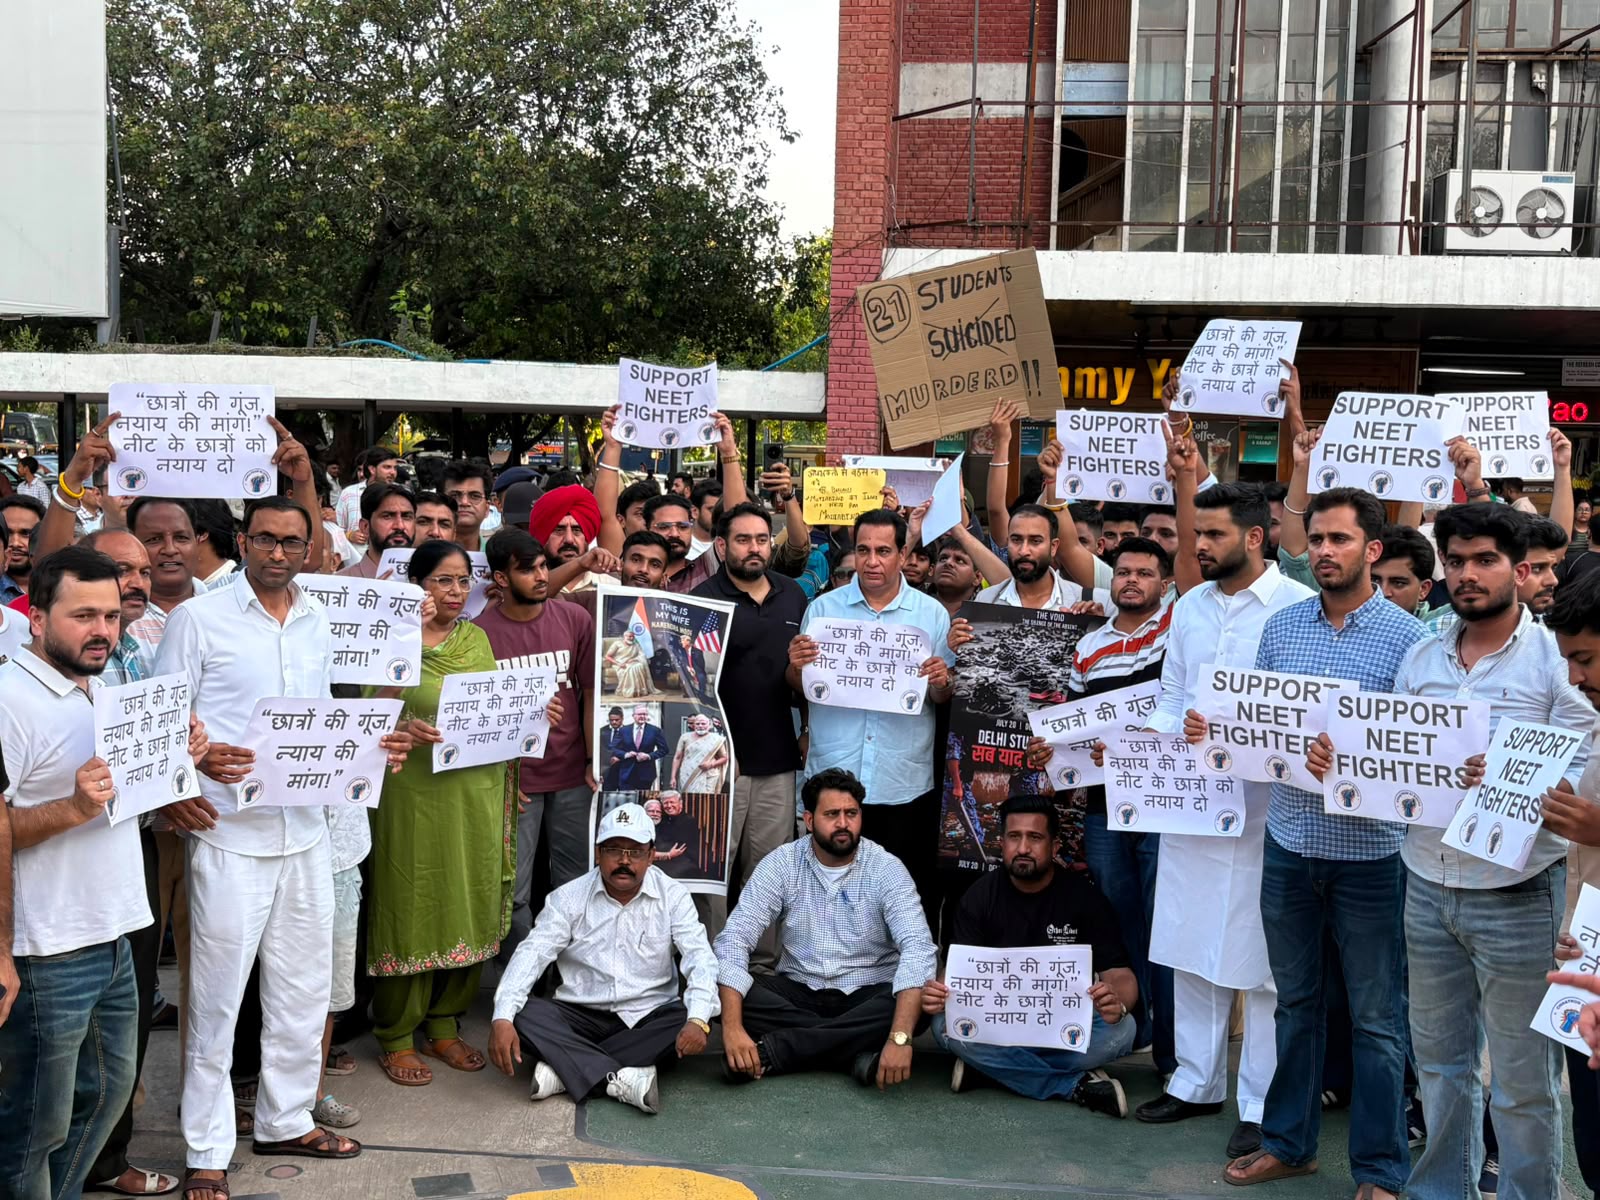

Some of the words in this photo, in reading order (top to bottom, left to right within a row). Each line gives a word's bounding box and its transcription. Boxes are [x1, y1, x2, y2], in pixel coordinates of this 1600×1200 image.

[867, 290, 907, 333] 21
[917, 266, 1013, 311] STUDENTS
[1240, 326, 1256, 342] की
[1193, 345, 1216, 357] याय
[1222, 342, 1240, 359] की
[630, 364, 711, 387] SUPPORT
[1184, 358, 1206, 374] नीट
[1211, 359, 1225, 375] के
[1231, 360, 1259, 376] छात्रों
[1265, 361, 1282, 377] को
[645, 387, 694, 405] NEET
[1242, 377, 1256, 395] दो
[137, 390, 187, 411] “छात्रों
[197, 391, 219, 411] की
[1334, 396, 1450, 420] SUPPORT
[1449, 395, 1535, 412] UPPORT
[1548, 398, 1589, 422] ao
[178, 412, 200, 432] की
[625, 402, 708, 424] FIGHTERS
[1069, 414, 1160, 434] SUPPORT
[1193, 421, 1208, 430] old
[1353, 421, 1417, 442] NEET
[1468, 415, 1517, 432] NEET
[123, 433, 157, 453] नीट
[168, 433, 185, 453] के
[195, 433, 236, 453] छात्रों
[245, 434, 267, 453] को
[1088, 436, 1138, 455] NEET
[1466, 435, 1541, 451] GHTERS
[217, 455, 235, 474] दो
[1067, 455, 1160, 477] FIGHTERS
[1322, 443, 1441, 469] FIGHTERS
[357, 588, 381, 610] की
[660, 602, 678, 613] THIS
[680, 607, 688, 615] IS
[655, 611, 670, 619] MY
[671, 614, 691, 626] WIFE
[1036, 611, 1048, 620] THE
[1050, 612, 1064, 622] VOID
[369, 620, 391, 640] की
[825, 624, 863, 640] “छात्रों
[870, 627, 888, 643] की
[854, 641, 872, 658] की
[812, 654, 839, 670] नीट
[845, 656, 859, 672] के
[866, 660, 897, 676] छात्रों
[461, 677, 495, 695] “छात्रों
[501, 675, 518, 692] की
[881, 676, 896, 692] दो
[153, 684, 166, 707] की
[487, 694, 503, 710] की
[262, 708, 316, 730] “छात्रों
[324, 708, 350, 730] की
[447, 715, 471, 732] नीट
[478, 713, 491, 729] के
[497, 708, 524, 727] छात्रों
[530, 707, 545, 721] को
[1041, 707, 1087, 734] “छात्रों
[1095, 702, 1117, 722] की
[1237, 701, 1307, 728] NEET
[1338, 696, 1468, 728] SUPPORT
[141, 711, 153, 734] की
[996, 719, 1008, 727] JULY
[1009, 720, 1016, 728] 20
[507, 726, 520, 741] दो
[978, 729, 1007, 747] DELHI
[1366, 728, 1437, 756] NEET
[1504, 727, 1579, 759] SUPPORT
[107, 745, 128, 768] नीट
[134, 738, 143, 761] के
[148, 729, 170, 756] छात्रों
[175, 725, 188, 747] को
[276, 745, 327, 762] न्याय
[334, 739, 359, 761] की
[1120, 737, 1161, 753] “छात्रों
[1170, 737, 1190, 754] की
[158, 753, 169, 777] दो
[972, 745, 997, 764] सब
[998, 748, 1025, 768] याद
[1157, 754, 1176, 772] की
[1337, 754, 1470, 790] FIGHTERS
[1498, 757, 1543, 786] NEET
[1116, 771, 1143, 789] नीट
[1152, 772, 1165, 790] के
[1173, 775, 1207, 792] छात्रों
[1216, 776, 1234, 794] को
[1193, 794, 1208, 812] दो
[1475, 784, 1540, 824] FIGHTERS
[958, 859, 970, 868] JULY
[971, 861, 978, 869] 20
[968, 957, 1011, 974] “छात्रों
[1020, 957, 1040, 974] की
[1003, 974, 1023, 991] की
[956, 992, 985, 1007] नीट
[994, 992, 1009, 1008] के
[1018, 992, 1053, 1008] छात्रों
[1062, 993, 1082, 1009] को
[1037, 1009, 1053, 1026] दो
